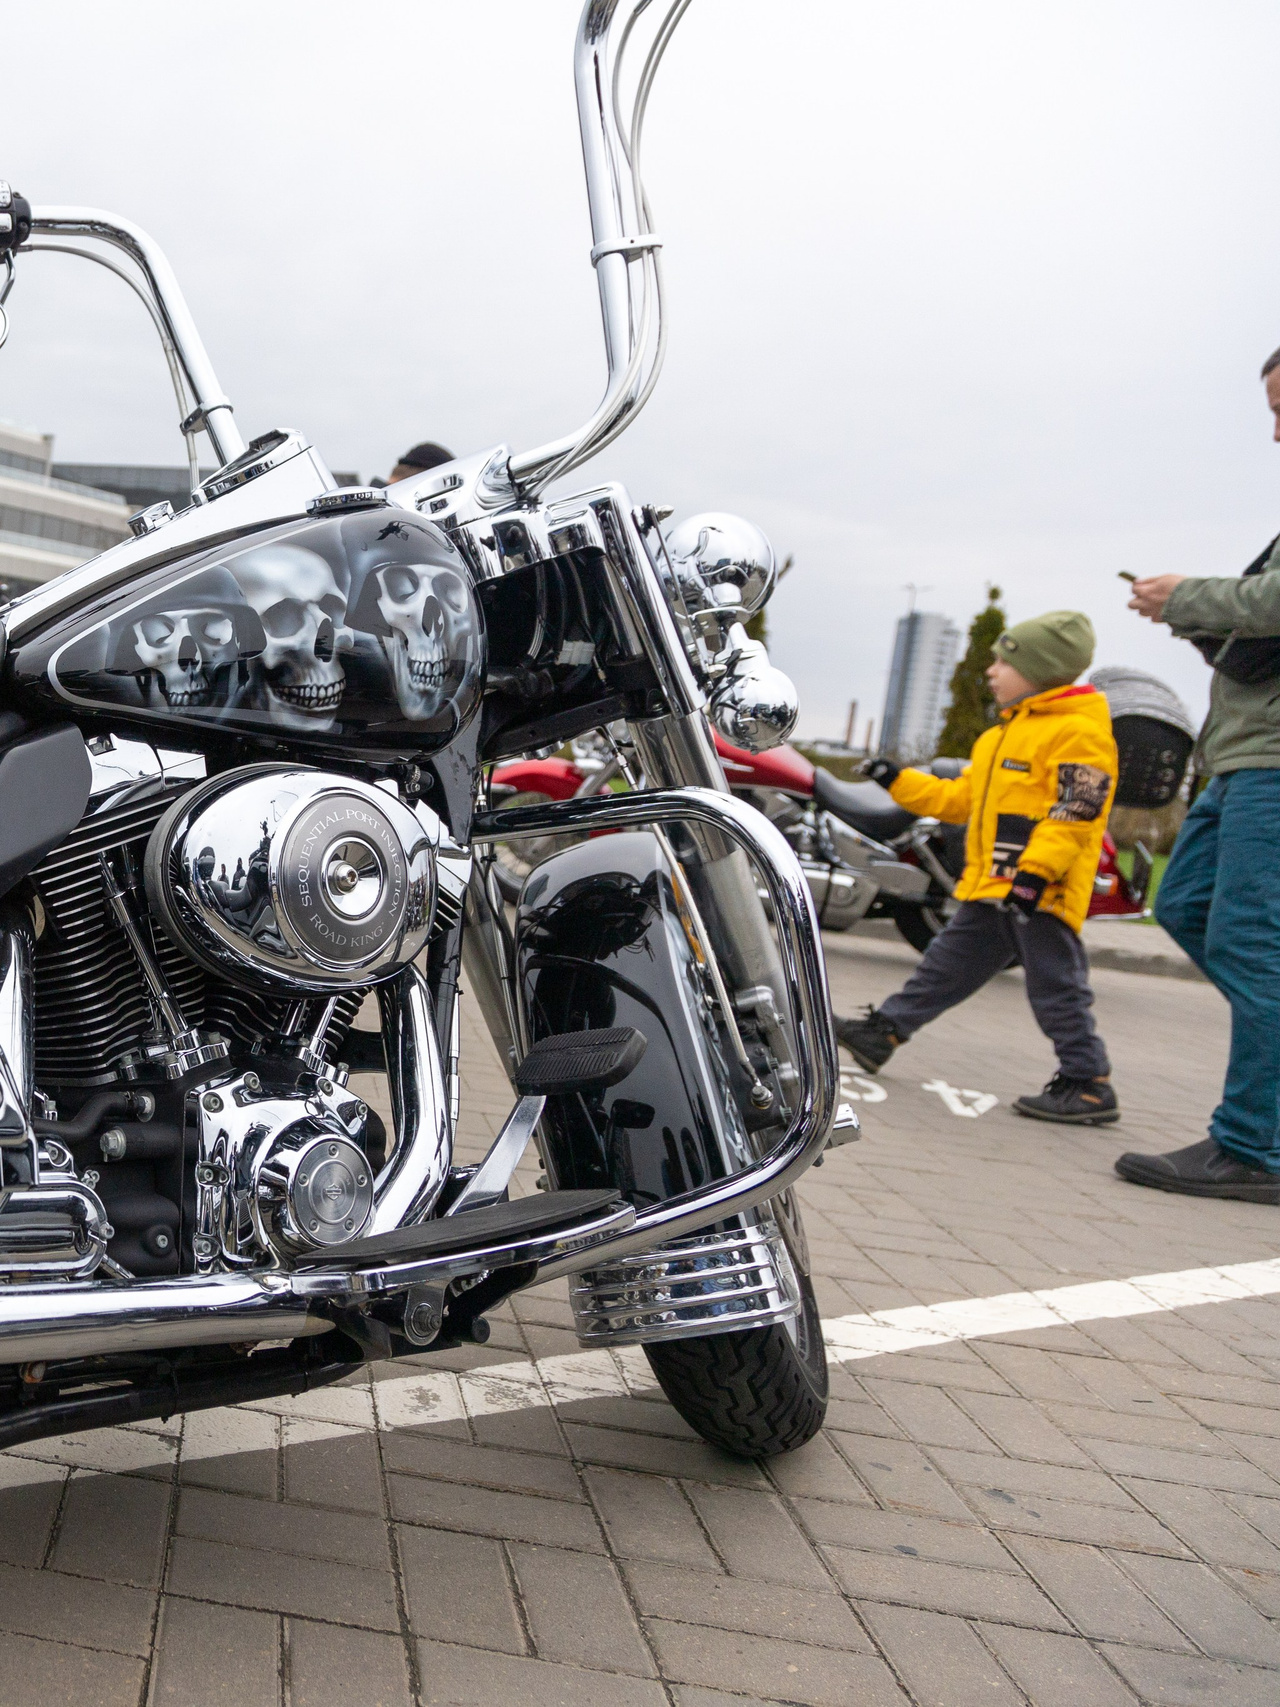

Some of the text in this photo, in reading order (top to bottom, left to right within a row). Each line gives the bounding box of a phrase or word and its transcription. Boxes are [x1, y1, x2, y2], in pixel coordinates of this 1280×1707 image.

[297, 809, 402, 917] SEQUENTIAL PORT INJECTION
[309, 913, 384, 948] ROAD KING
